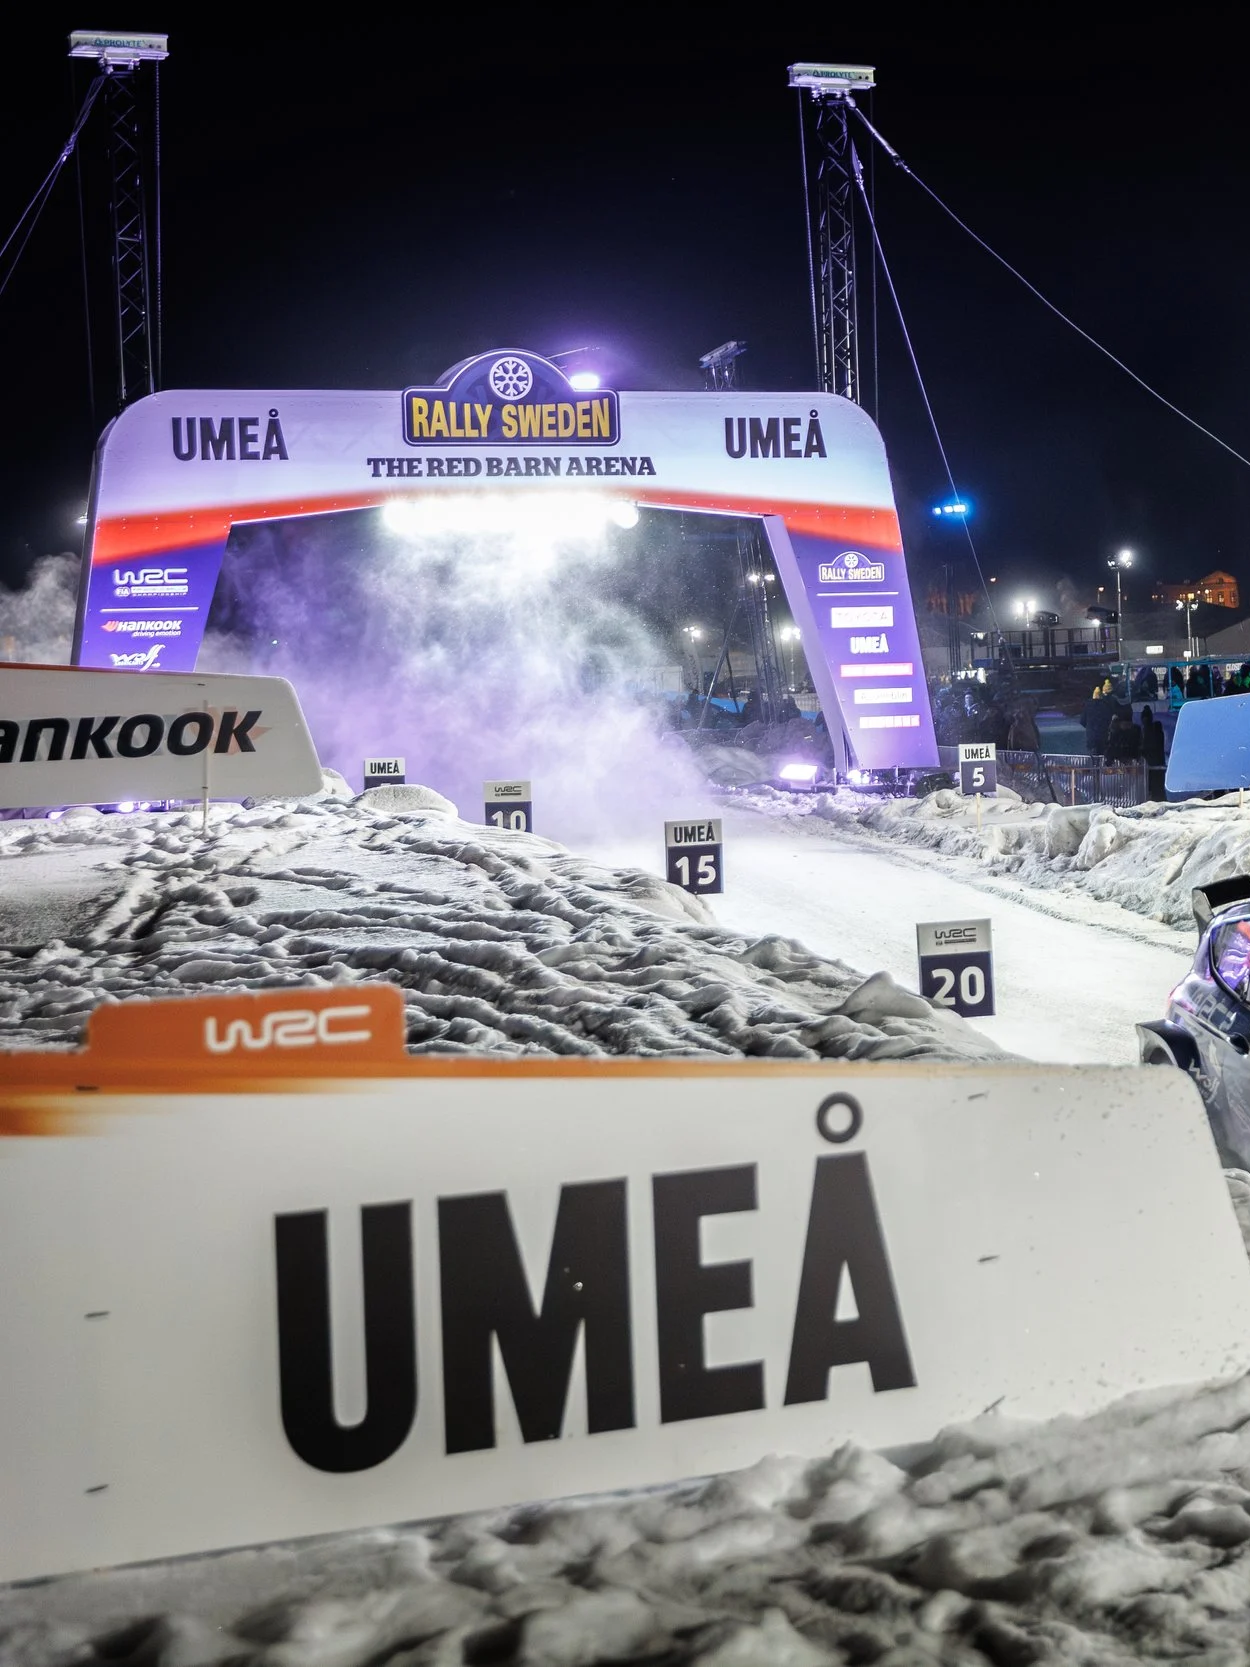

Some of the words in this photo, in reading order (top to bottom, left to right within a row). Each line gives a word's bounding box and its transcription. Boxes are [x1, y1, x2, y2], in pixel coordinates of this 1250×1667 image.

[412, 397, 492, 438] RALLY
[502, 397, 611, 438] SWEDEN
[171, 409, 289, 462] UMEÅ
[724, 409, 827, 459] UMEÅ
[366, 457, 423, 478] THE
[426, 457, 483, 478] RED
[486, 456, 562, 477] BARN
[565, 456, 657, 477] ARENA
[113, 568, 188, 585] WRC
[821, 566, 847, 580] RALLY
[848, 565, 882, 580] SWEDEN
[850, 633, 889, 654] UMEÅ
[964, 745, 991, 760] UMEÅ
[370, 760, 400, 774] UMEÅ
[972, 766, 985, 787] 5
[494, 785, 522, 793] WRC
[491, 810, 527, 833] 10
[673, 821, 715, 844] UMEÅ
[674, 854, 717, 886] 15
[934, 927, 977, 939] WRC
[931, 965, 986, 1006] 20
[204, 1004, 372, 1053] WRC
[273, 1091, 918, 1474] UMEÅ
